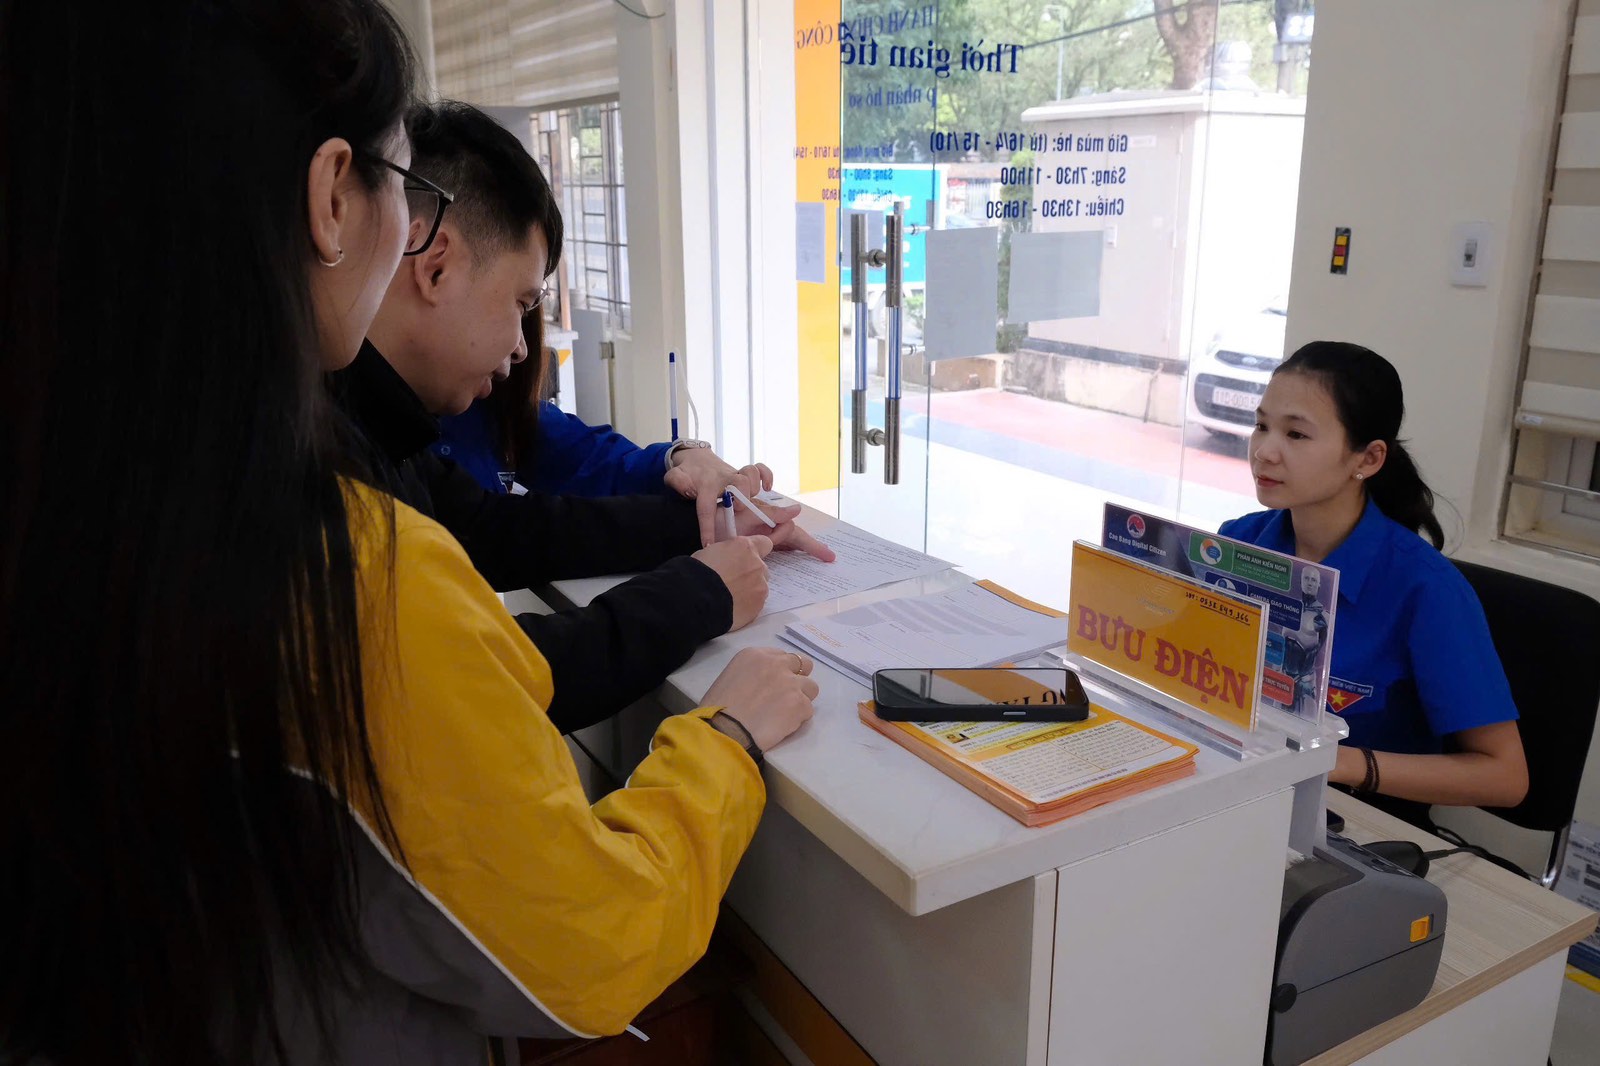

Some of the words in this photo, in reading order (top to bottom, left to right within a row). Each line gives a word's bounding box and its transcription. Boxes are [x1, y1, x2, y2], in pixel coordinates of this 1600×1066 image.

[1283, 603, 1300, 614] THÔNG
[1077, 604, 1146, 662] BƯU
[1153, 637, 1249, 709] ĐIỆN
